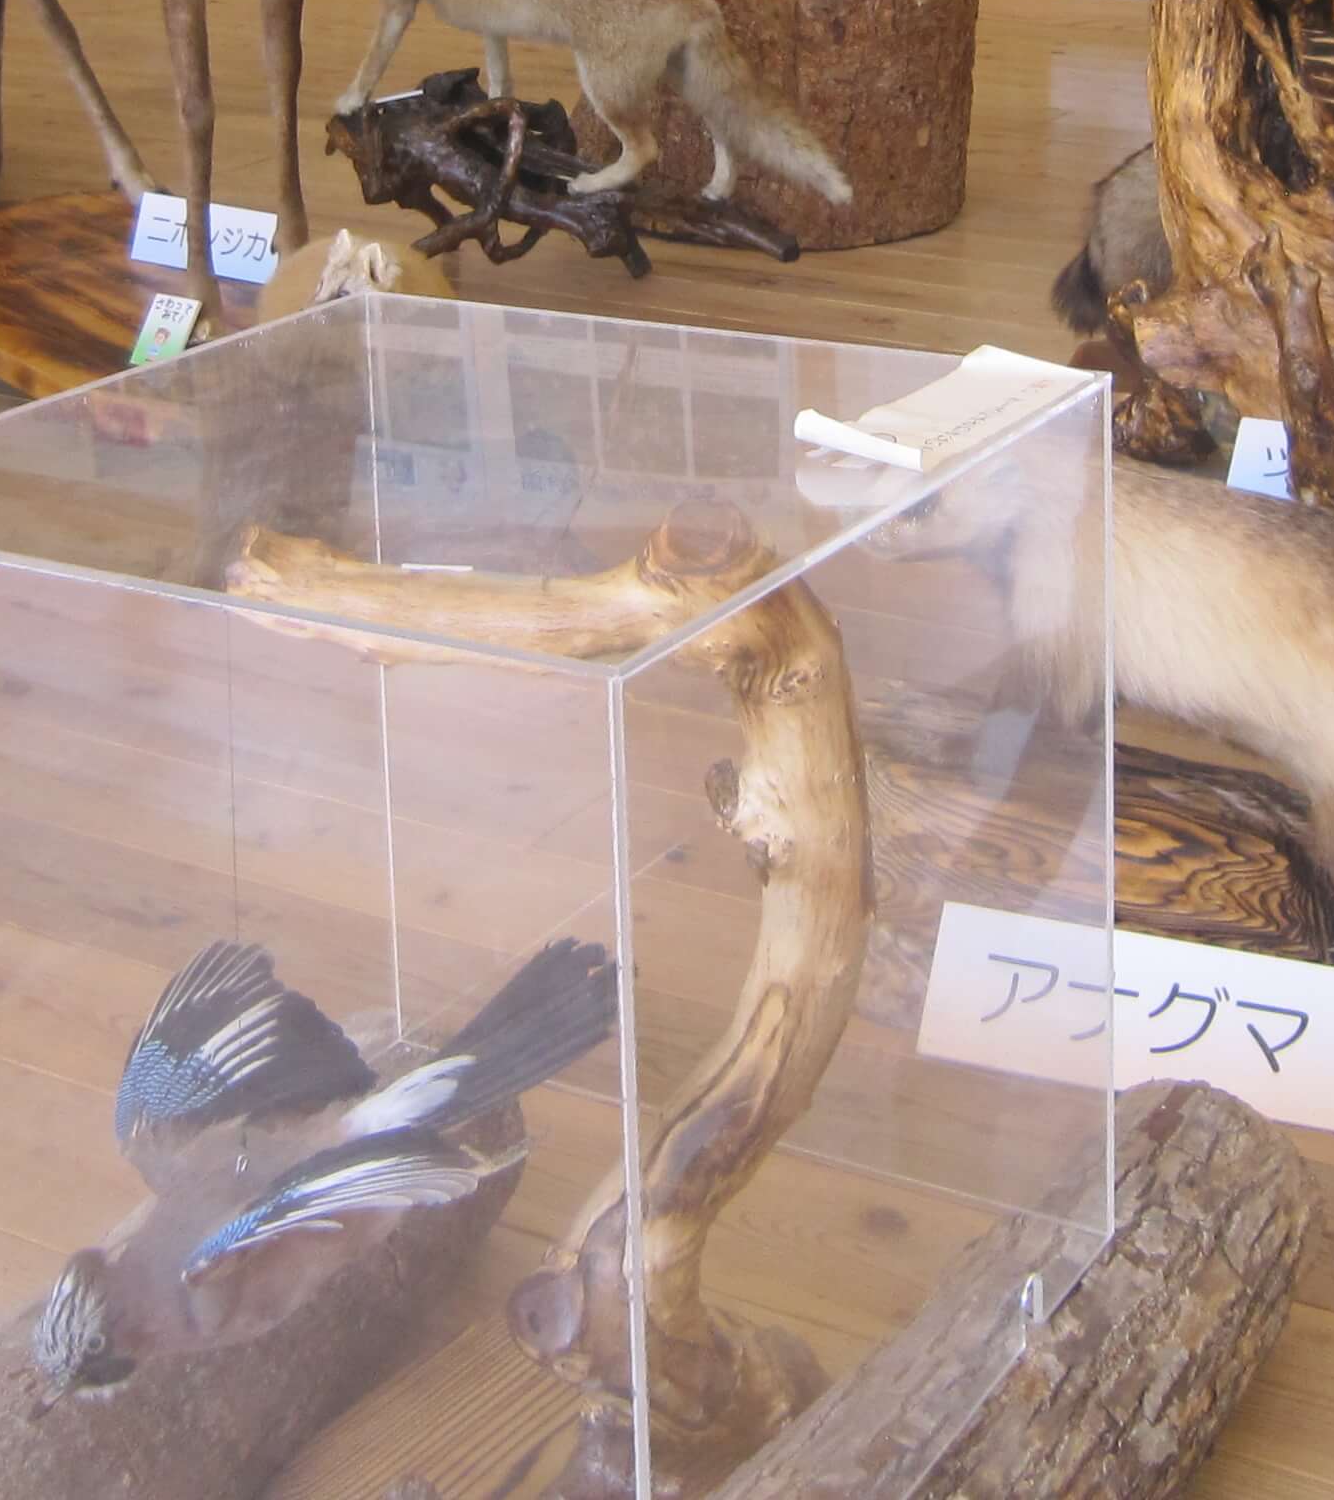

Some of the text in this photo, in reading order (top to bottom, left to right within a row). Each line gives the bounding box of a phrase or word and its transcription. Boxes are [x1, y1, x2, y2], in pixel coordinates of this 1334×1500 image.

[147, 216, 268, 262] ニホジカ
[980, 952, 1310, 1073] アナグマ
